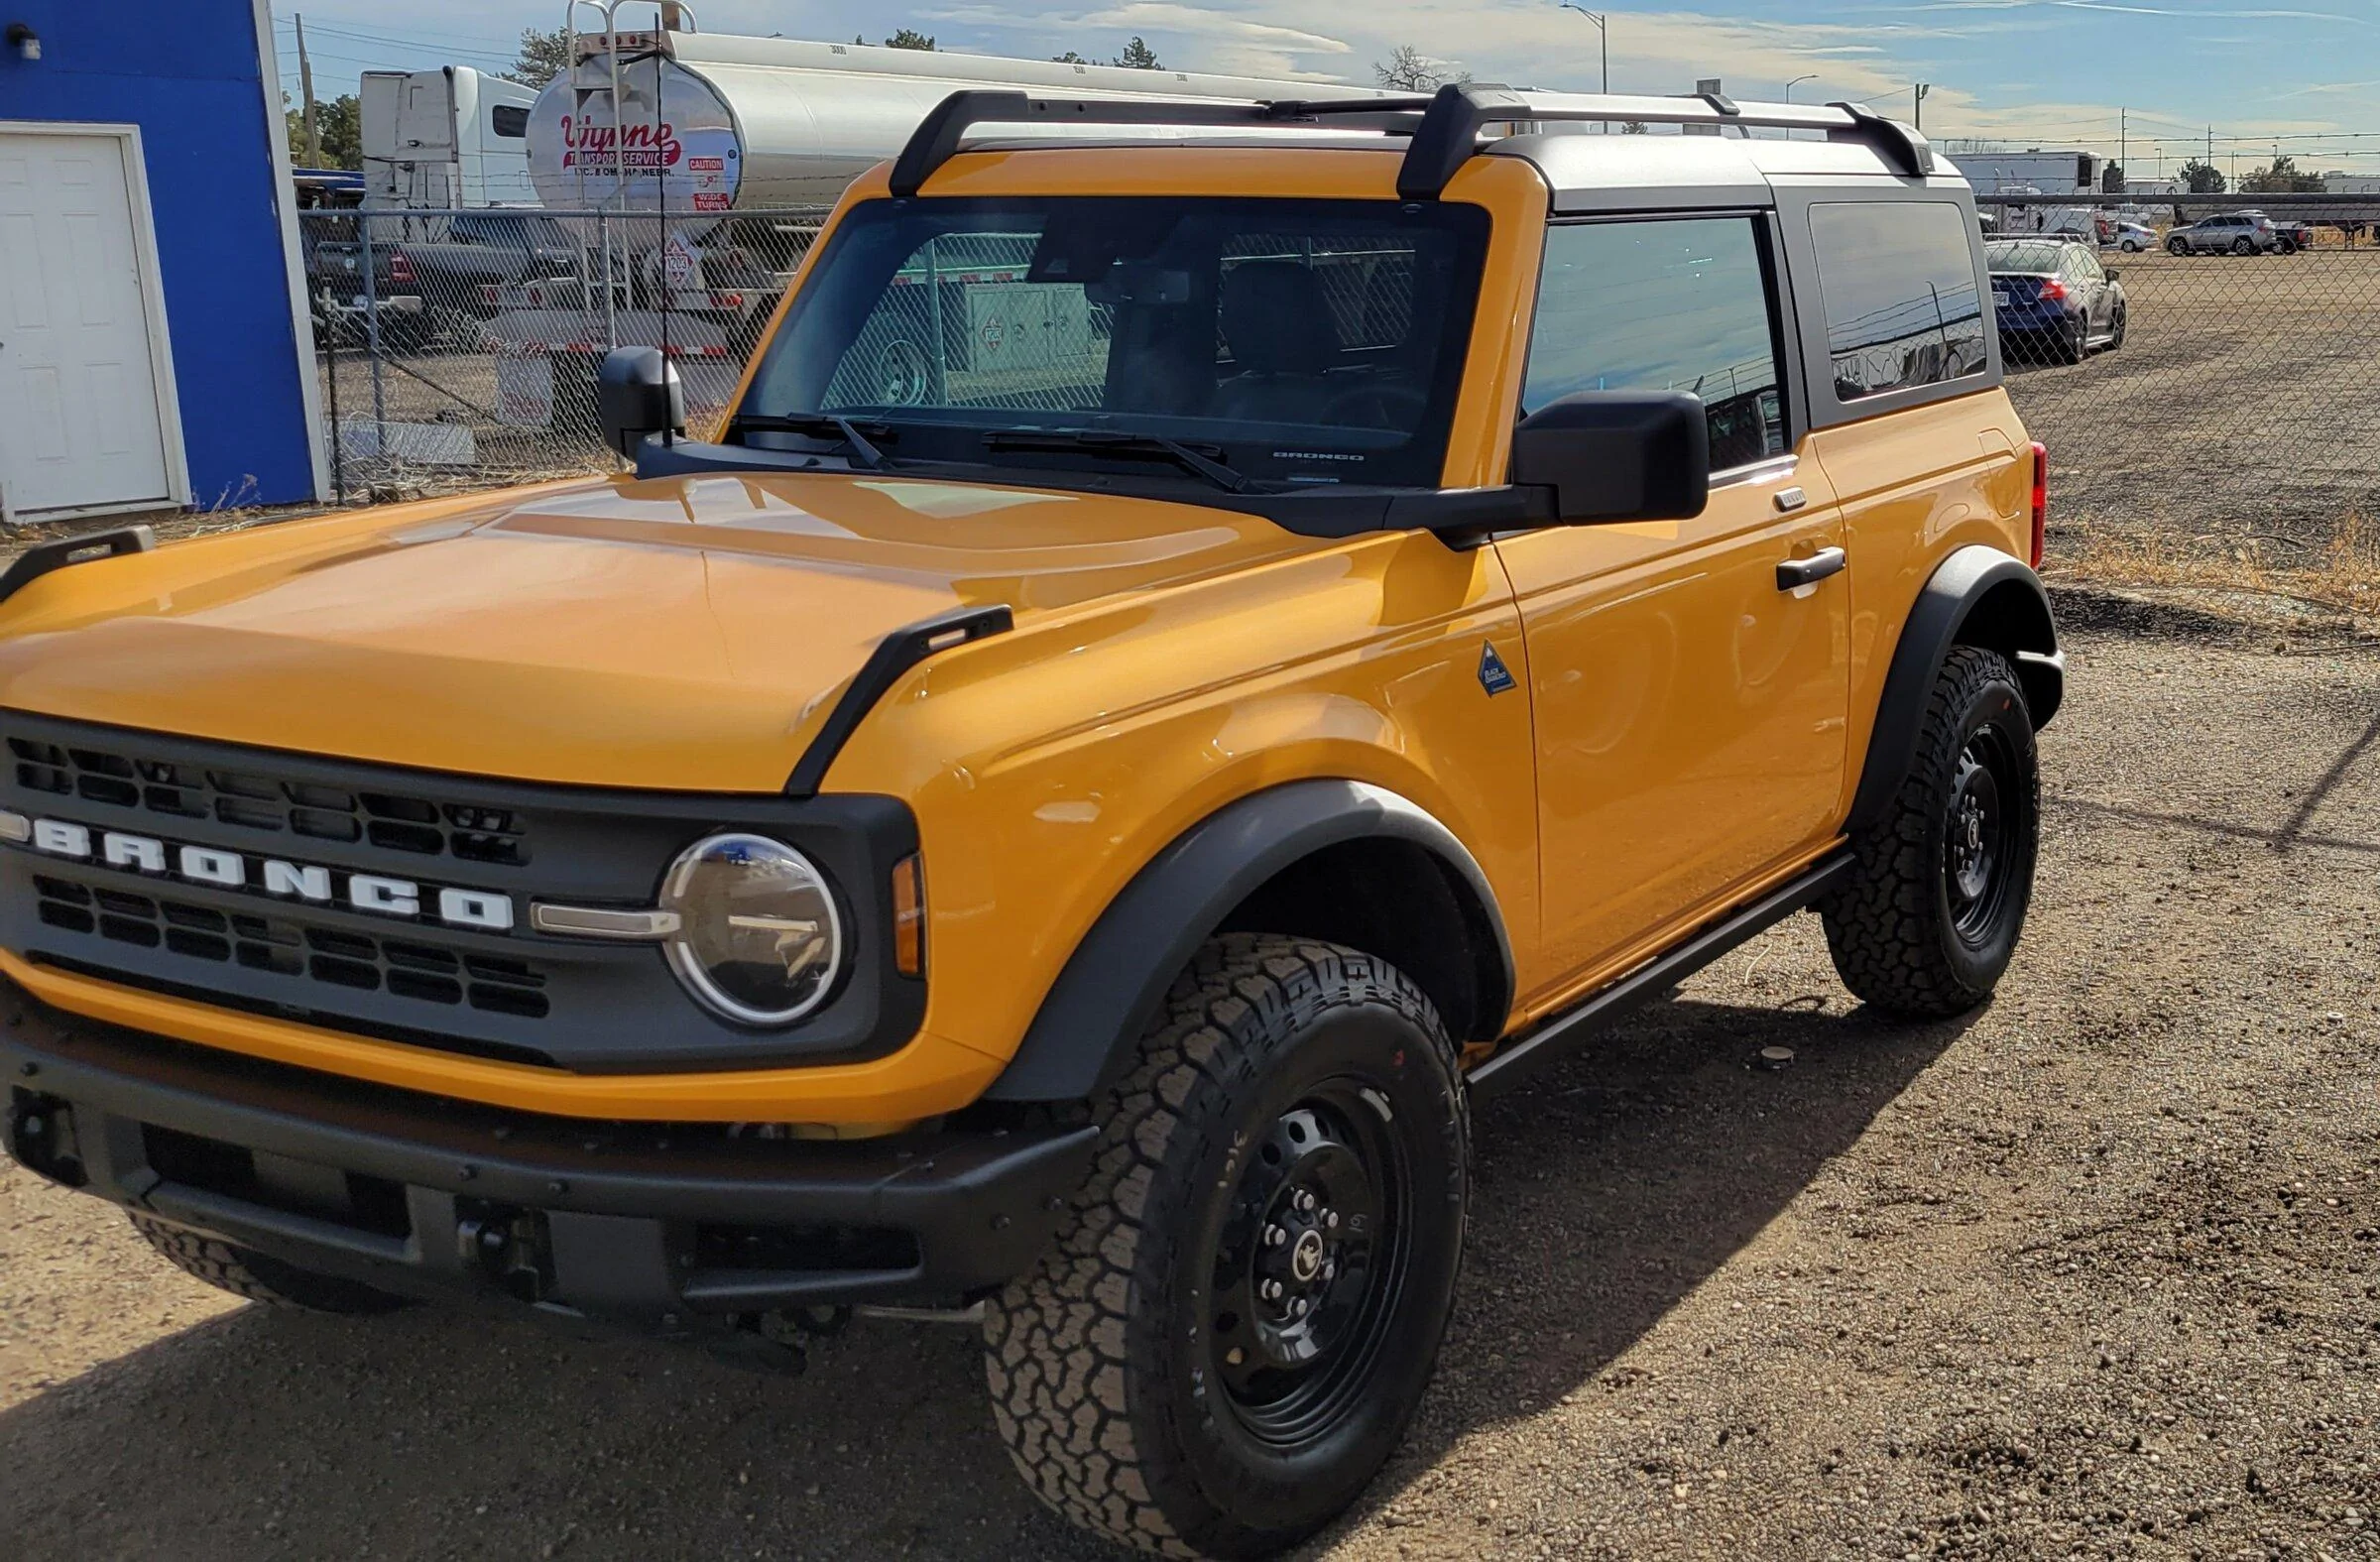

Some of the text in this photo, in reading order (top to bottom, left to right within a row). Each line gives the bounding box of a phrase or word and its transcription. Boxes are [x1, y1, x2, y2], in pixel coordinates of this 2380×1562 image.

[569, 152, 669, 165] TNSPOR SERVICE
[690, 160, 723, 170] CAUTION
[33, 818, 514, 929] BRONCO
